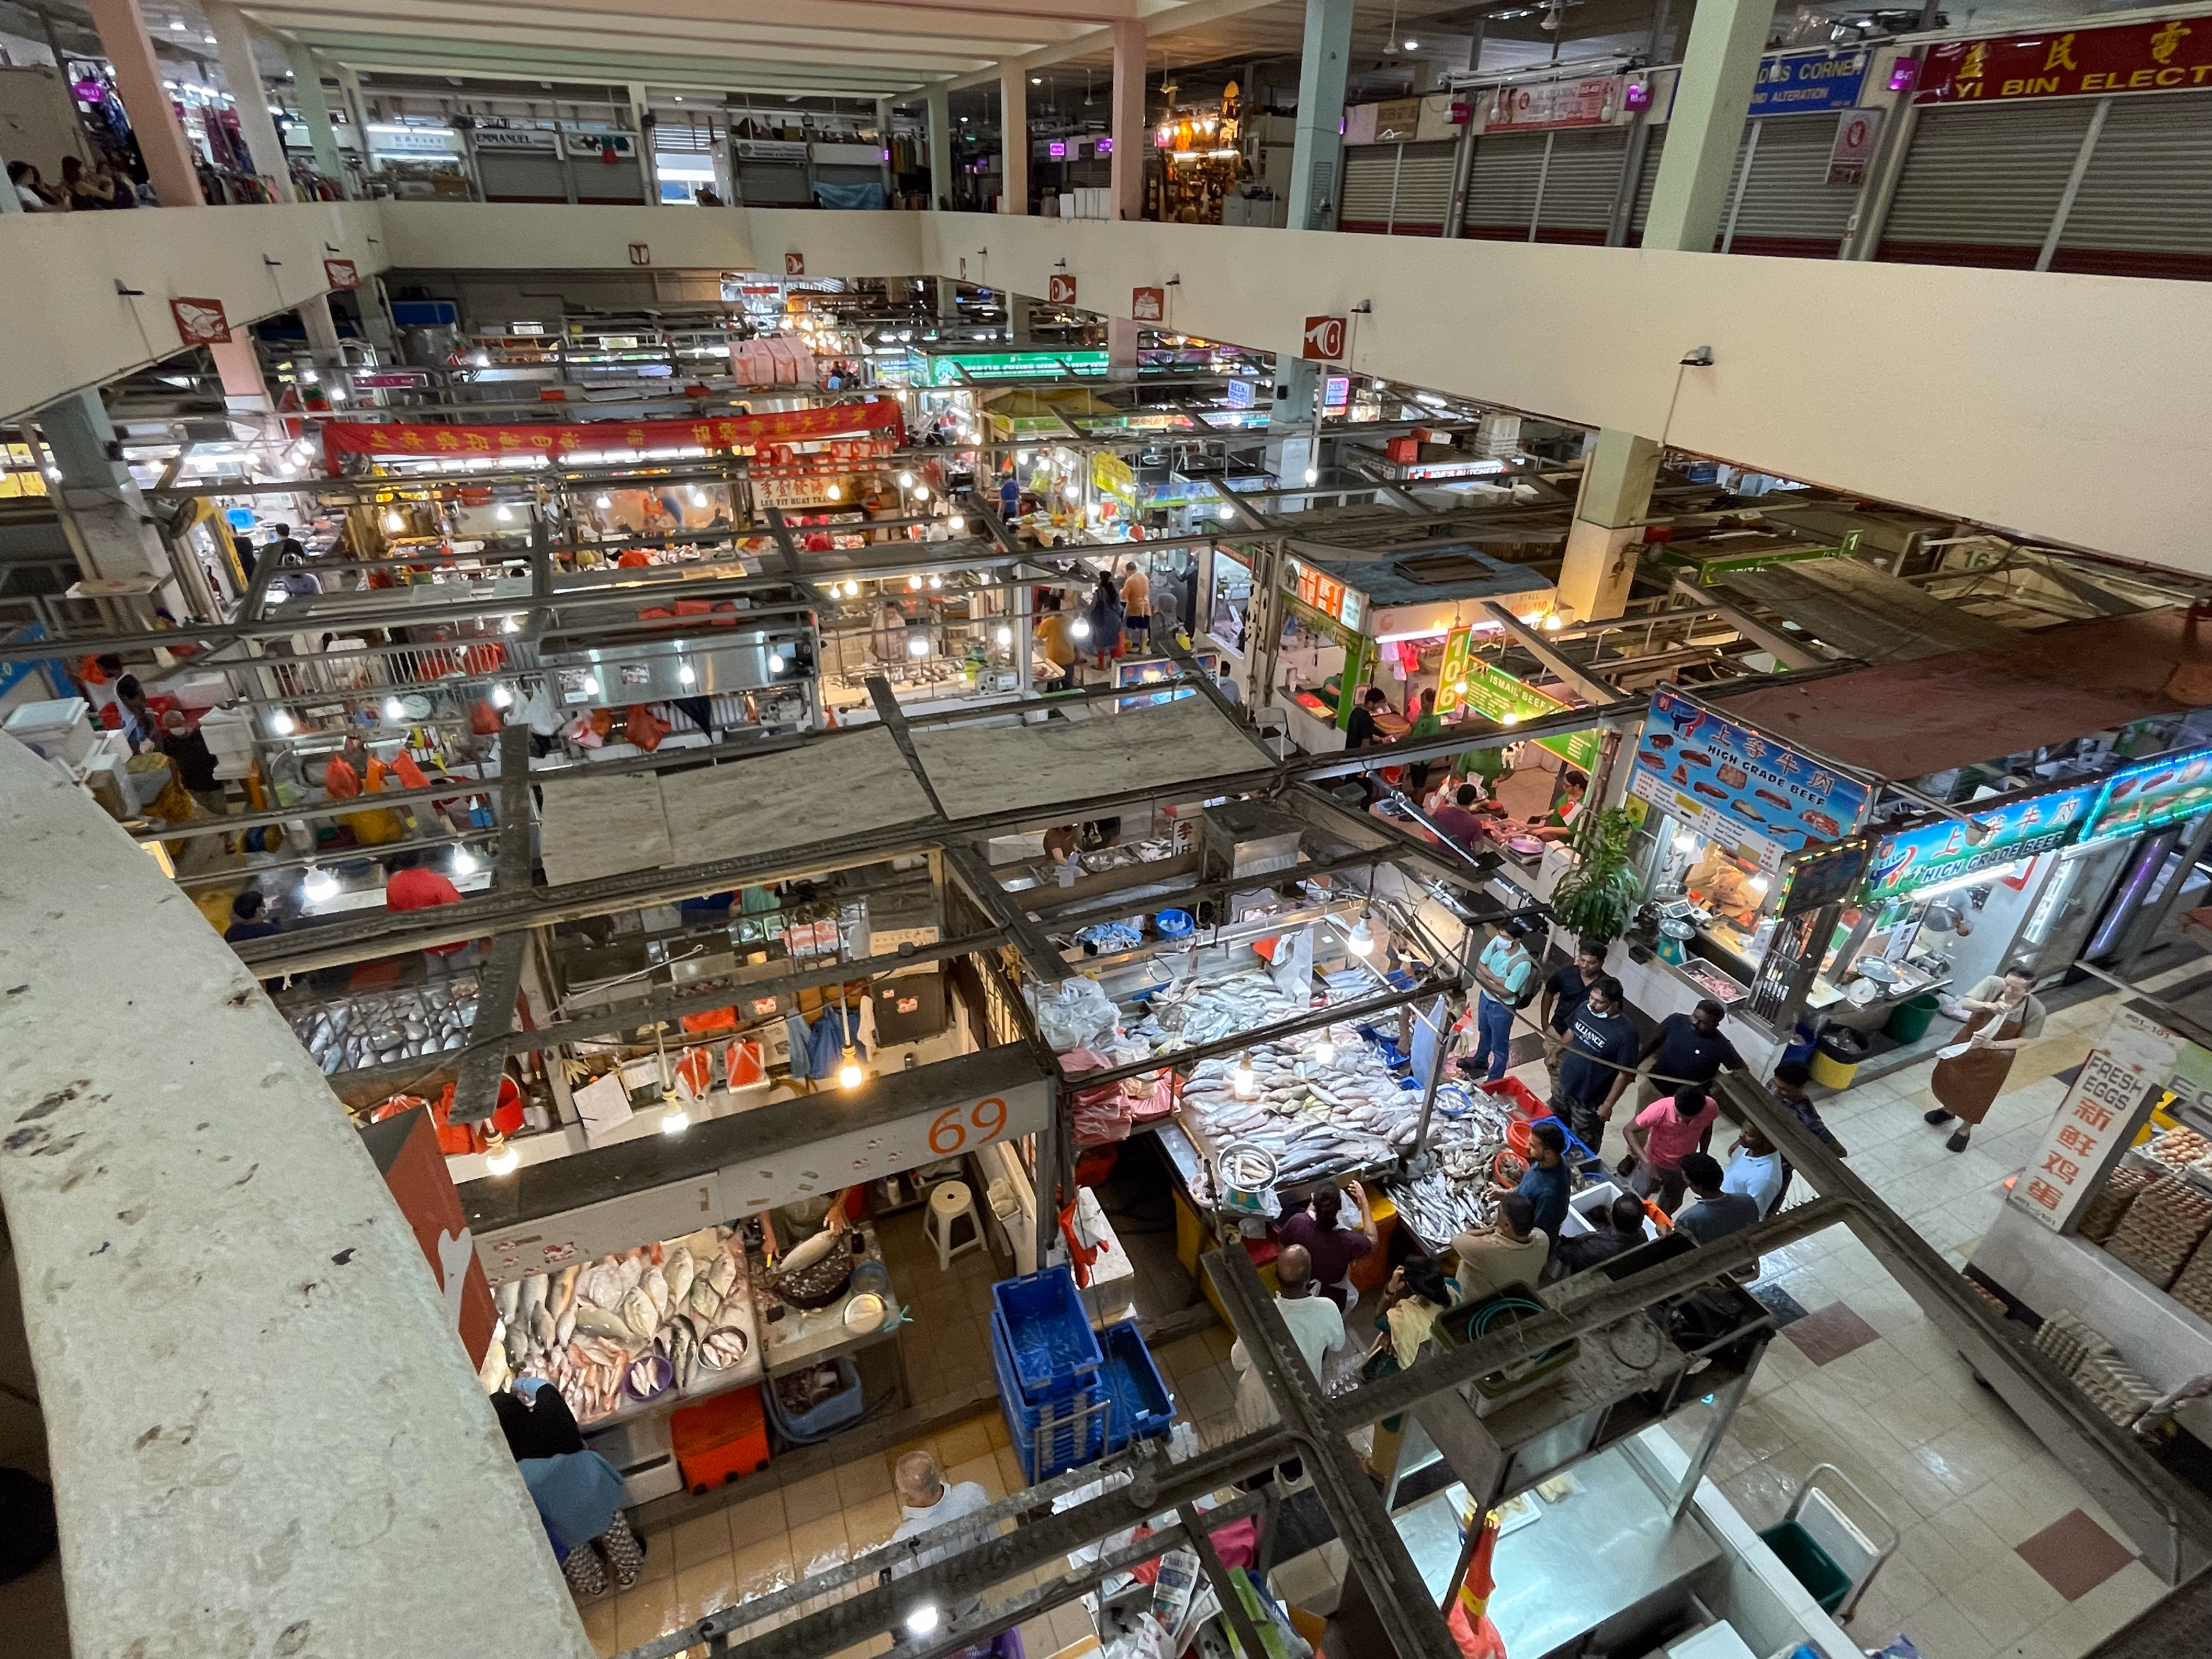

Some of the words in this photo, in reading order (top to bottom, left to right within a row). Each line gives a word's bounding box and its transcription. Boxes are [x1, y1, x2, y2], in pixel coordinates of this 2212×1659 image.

[1799, 58, 1861, 80] CORNE
[1956, 82, 1983, 99] YI
[2001, 76, 2060, 95] BIN
[2080, 65, 2212, 91] ELECT
[1770, 87, 1830, 103] ALTERATION
[1965, 550, 2000, 568] 16
[1520, 593, 1540, 602] STALL
[1521, 690, 1547, 710] BEEF
[1707, 744, 1738, 765] HIGH
[1742, 761, 1786, 788] GRADE
[1790, 784, 1826, 805] BEEF
[1710, 724, 1835, 796] 上等牛肉
[1922, 859, 1966, 884] HIGH
[1968, 843, 2022, 868] GRADE
[2021, 831, 2065, 855] BEEF
[1574, 1022, 1605, 1048] ALLIANCE
[2087, 1055, 2143, 1094] FRESH
[2082, 1075, 2131, 1111] EGGS
[928, 1097, 1007, 1155] 69
